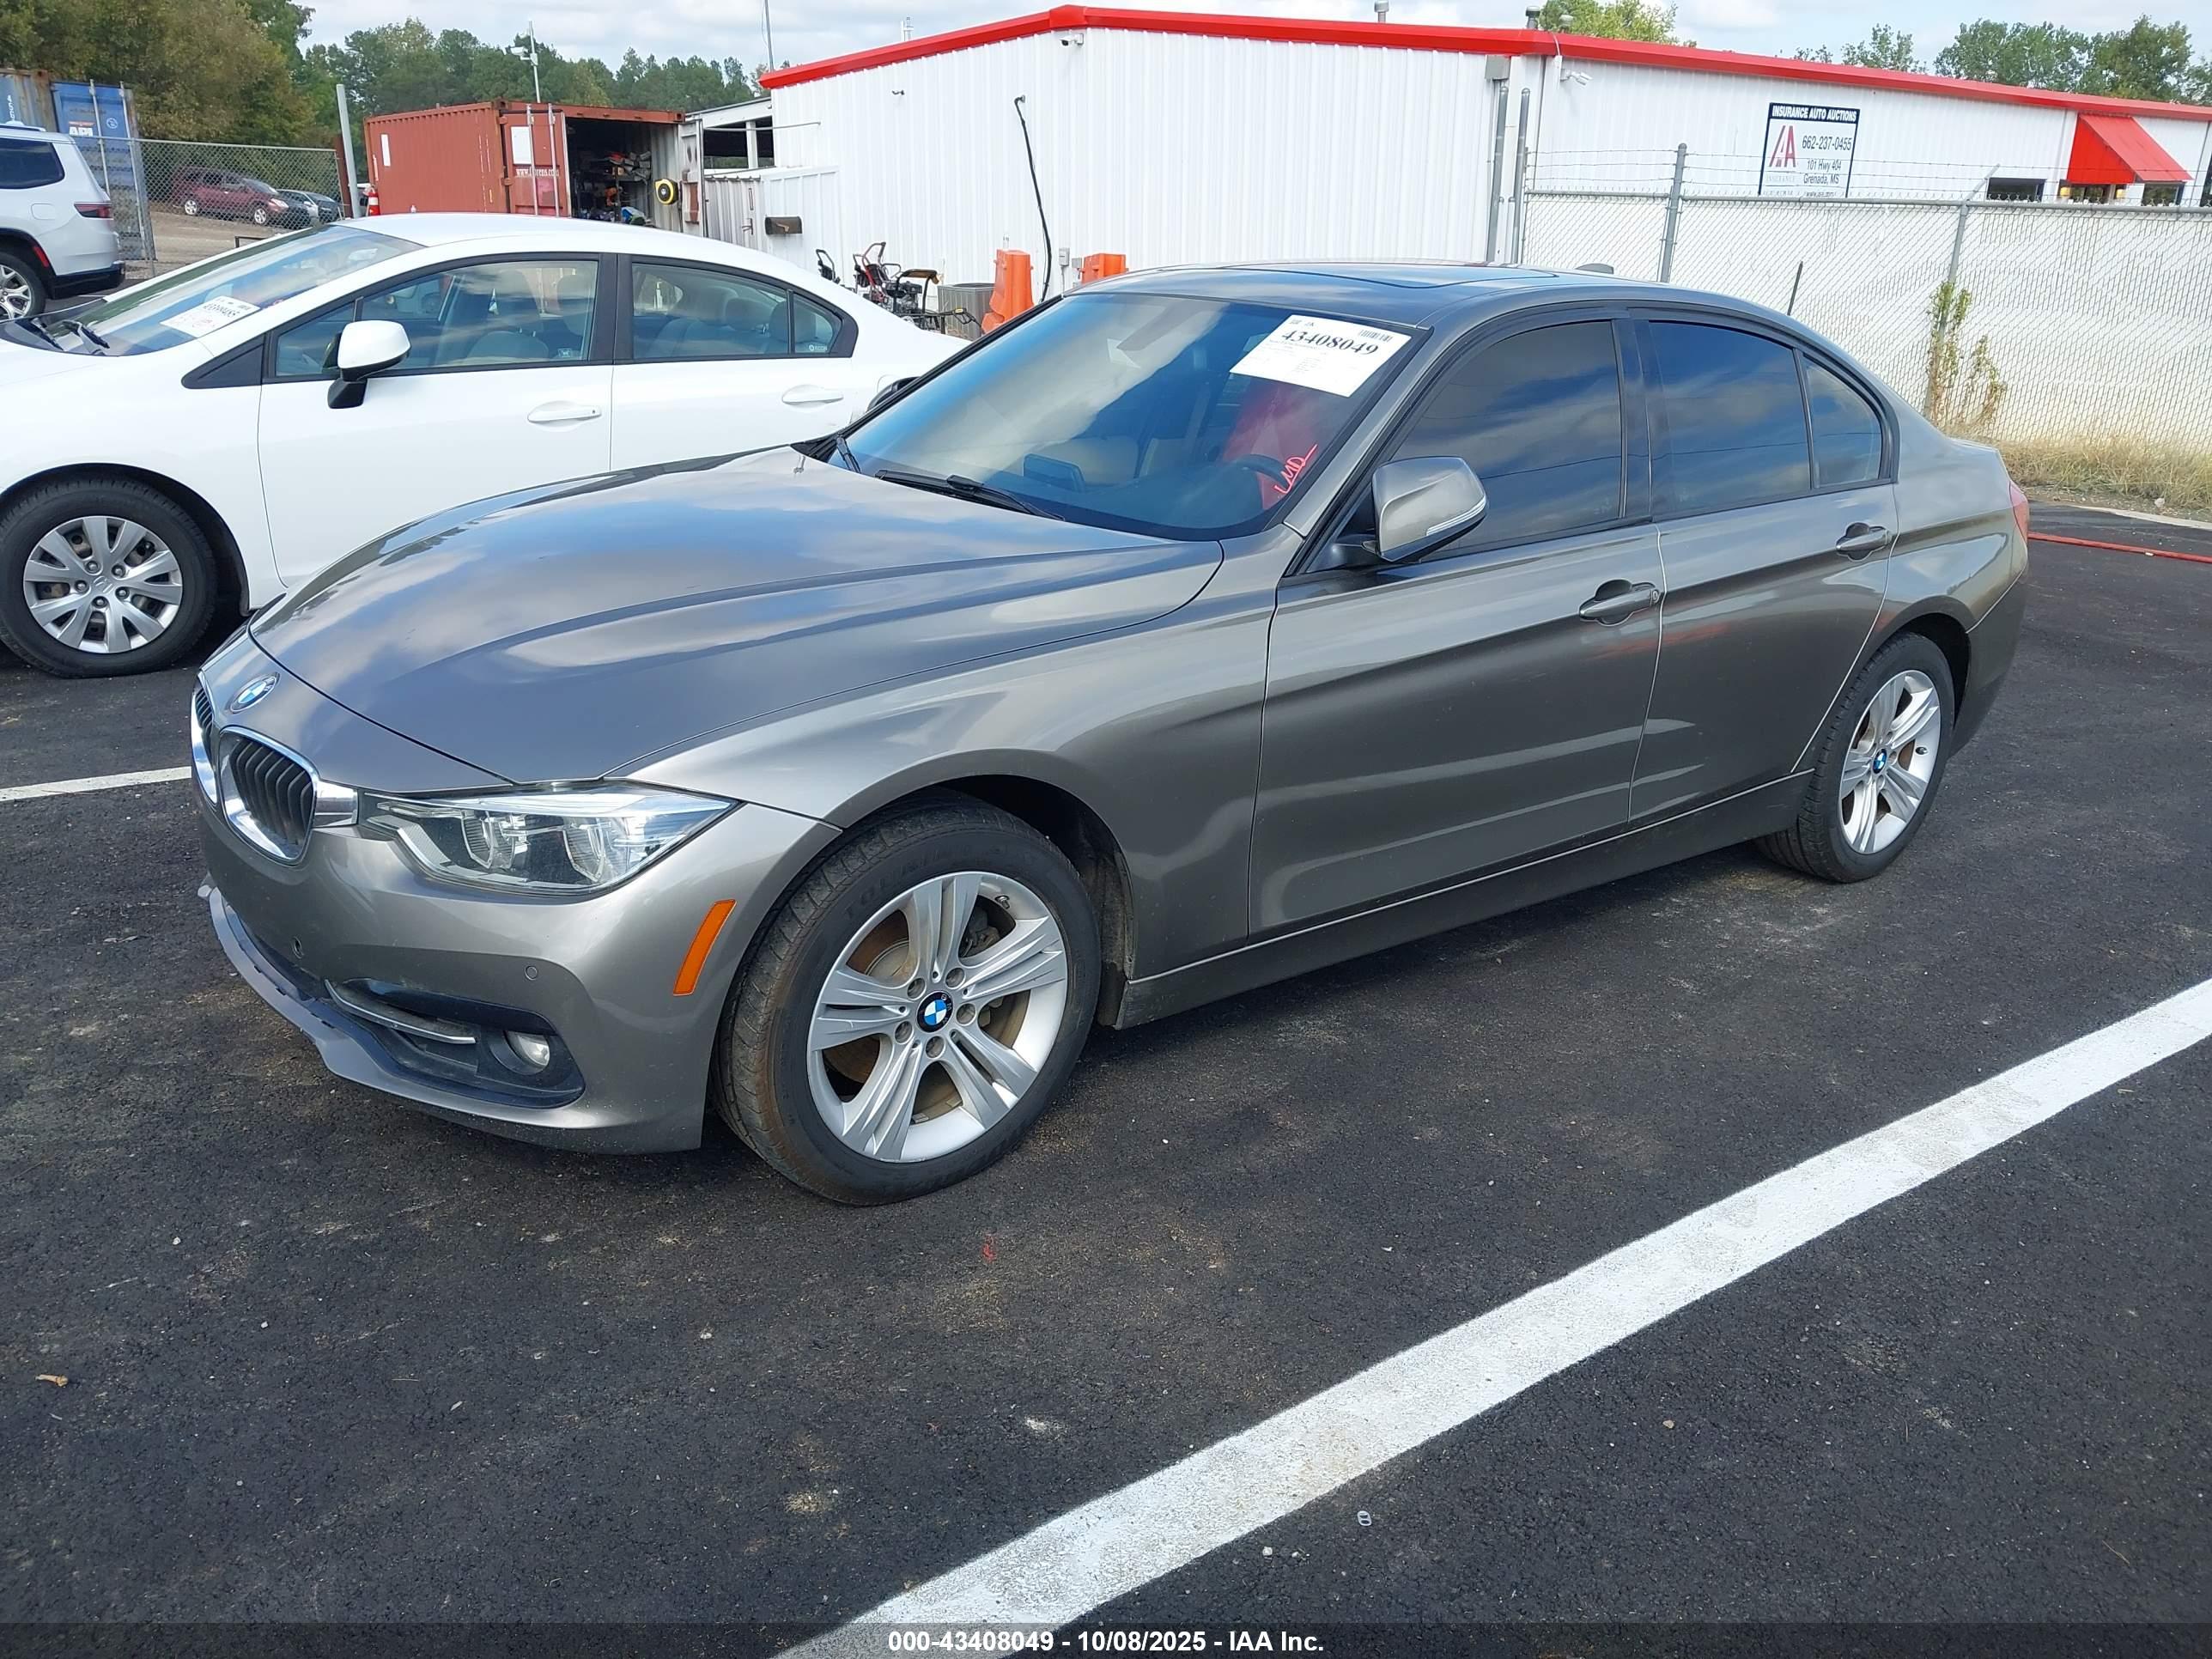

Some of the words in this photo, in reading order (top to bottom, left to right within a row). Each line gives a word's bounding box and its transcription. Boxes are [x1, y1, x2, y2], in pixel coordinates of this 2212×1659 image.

[1772, 105, 1808, 118] INSURANCE
[1808, 107, 1826, 120] AUTO
[1826, 109, 1857, 122] AUCTIONS
[1802, 135, 1852, 151] 662-237-0455
[1807, 159, 1817, 170] 101
[1818, 160, 1831, 173] Hwy
[1832, 161, 1842, 171] 404
[1803, 173, 1829, 185] Grenada,
[1830, 174, 1839, 184] MS
[1281, 330, 1379, 355] 43408049
